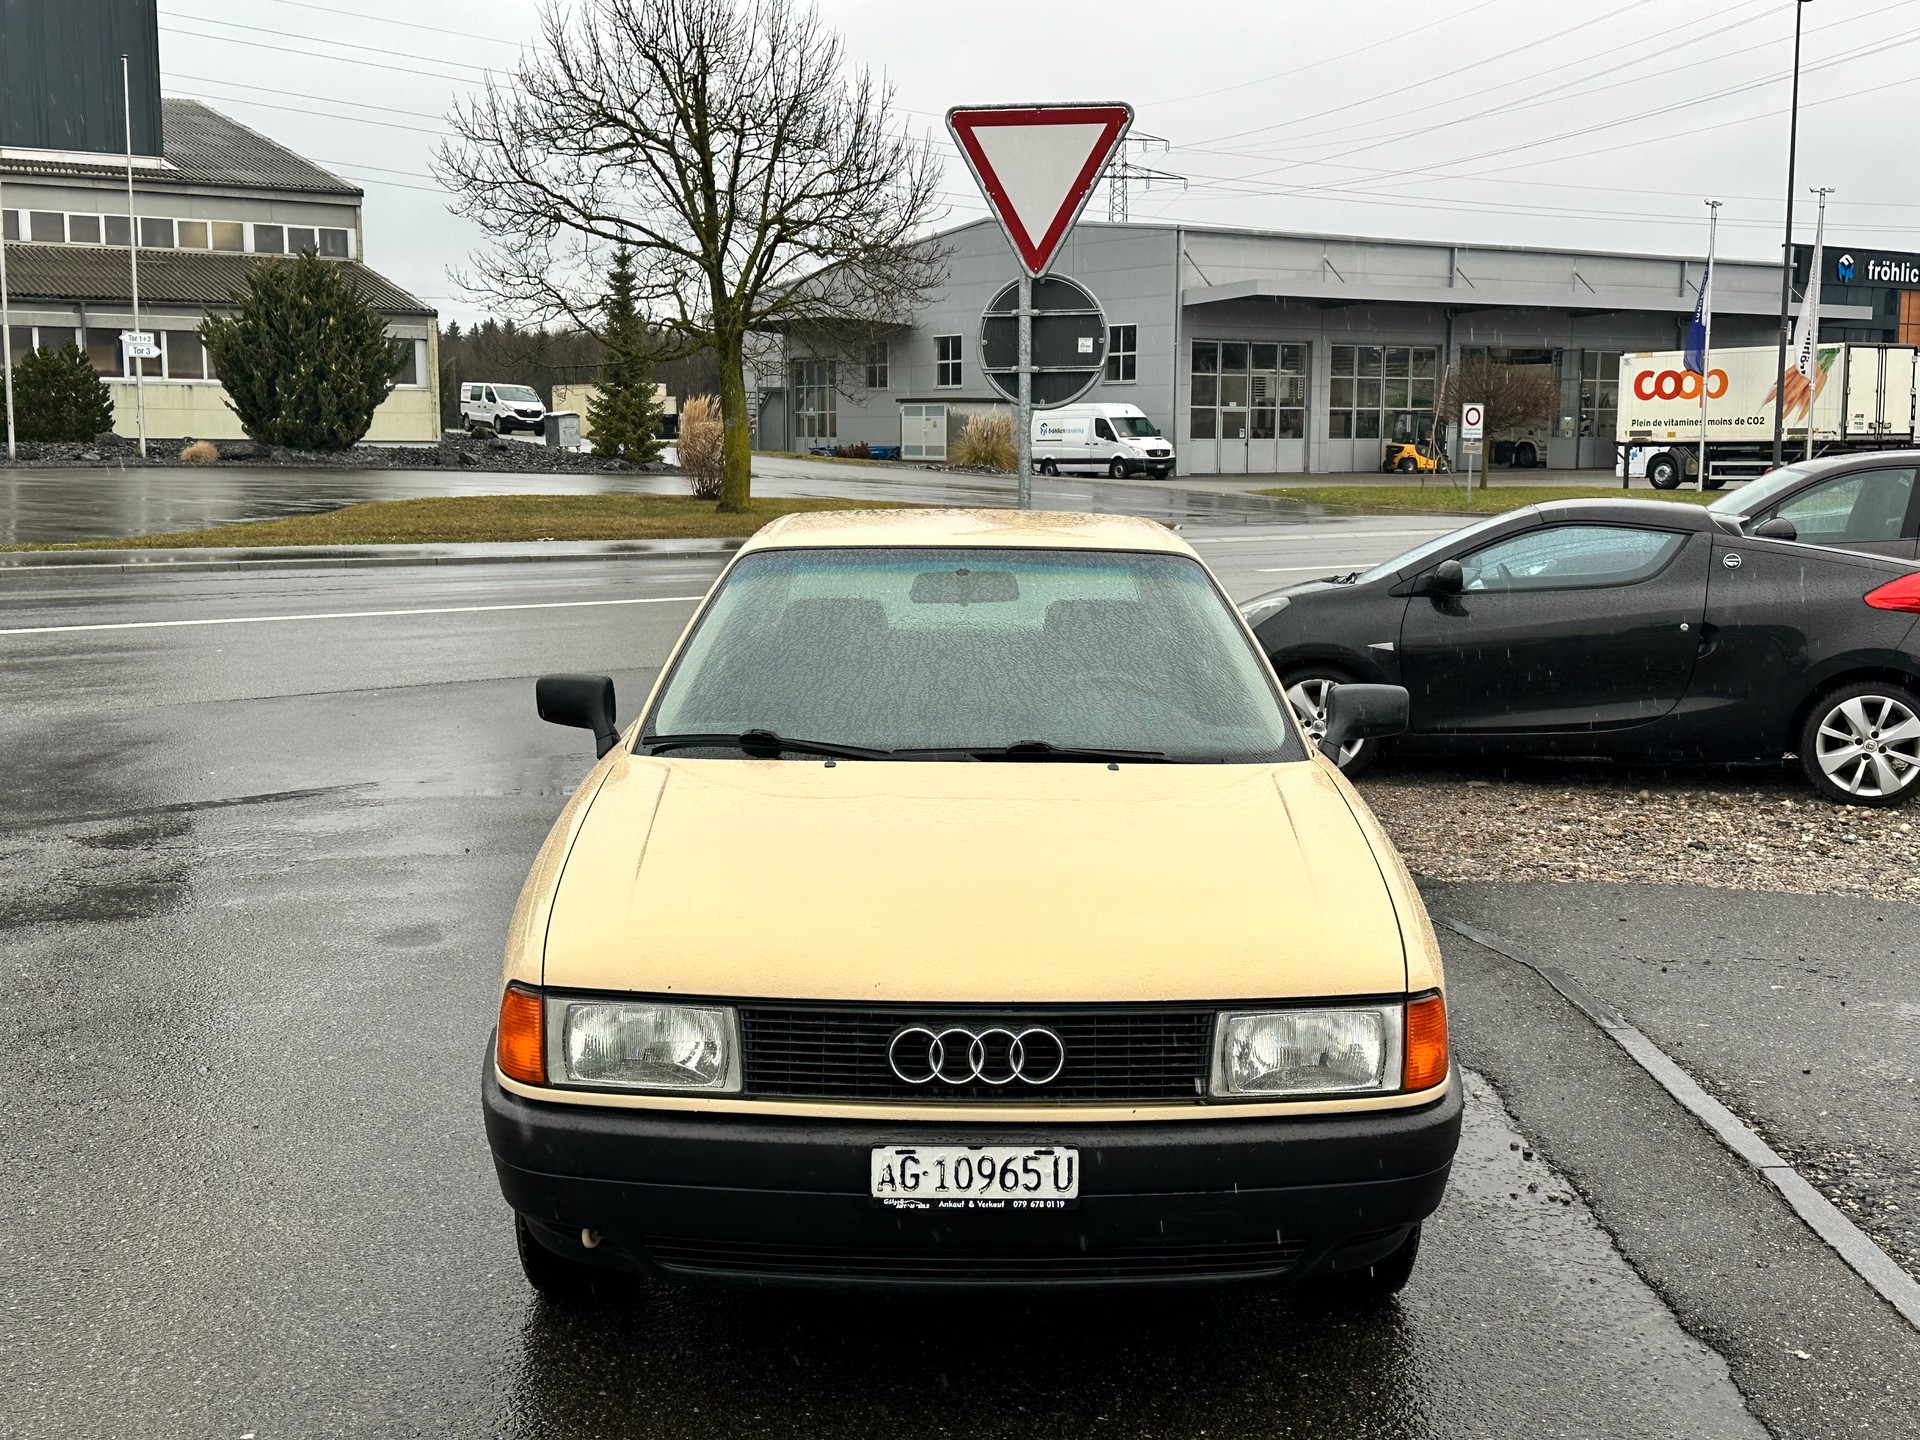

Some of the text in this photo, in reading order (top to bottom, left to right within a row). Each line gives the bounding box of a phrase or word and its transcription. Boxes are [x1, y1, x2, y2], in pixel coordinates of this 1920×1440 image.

[133, 346, 151, 355] Tor 3
[1634, 368, 1729, 409] coop
[1631, 418, 1651, 427] Plein
[1652, 419, 1662, 427] de
[1707, 417, 1733, 426] moins
[1734, 417, 1745, 425] de
[1746, 416, 1765, 425] CO2
[938, 1200, 964, 1208] Ankauf
[968, 1200, 974, 1208] &
[977, 1200, 1005, 1208] Verkauf
[1013, 1200, 1027, 1208] 079
[1030, 1200, 1044, 1208] 678
